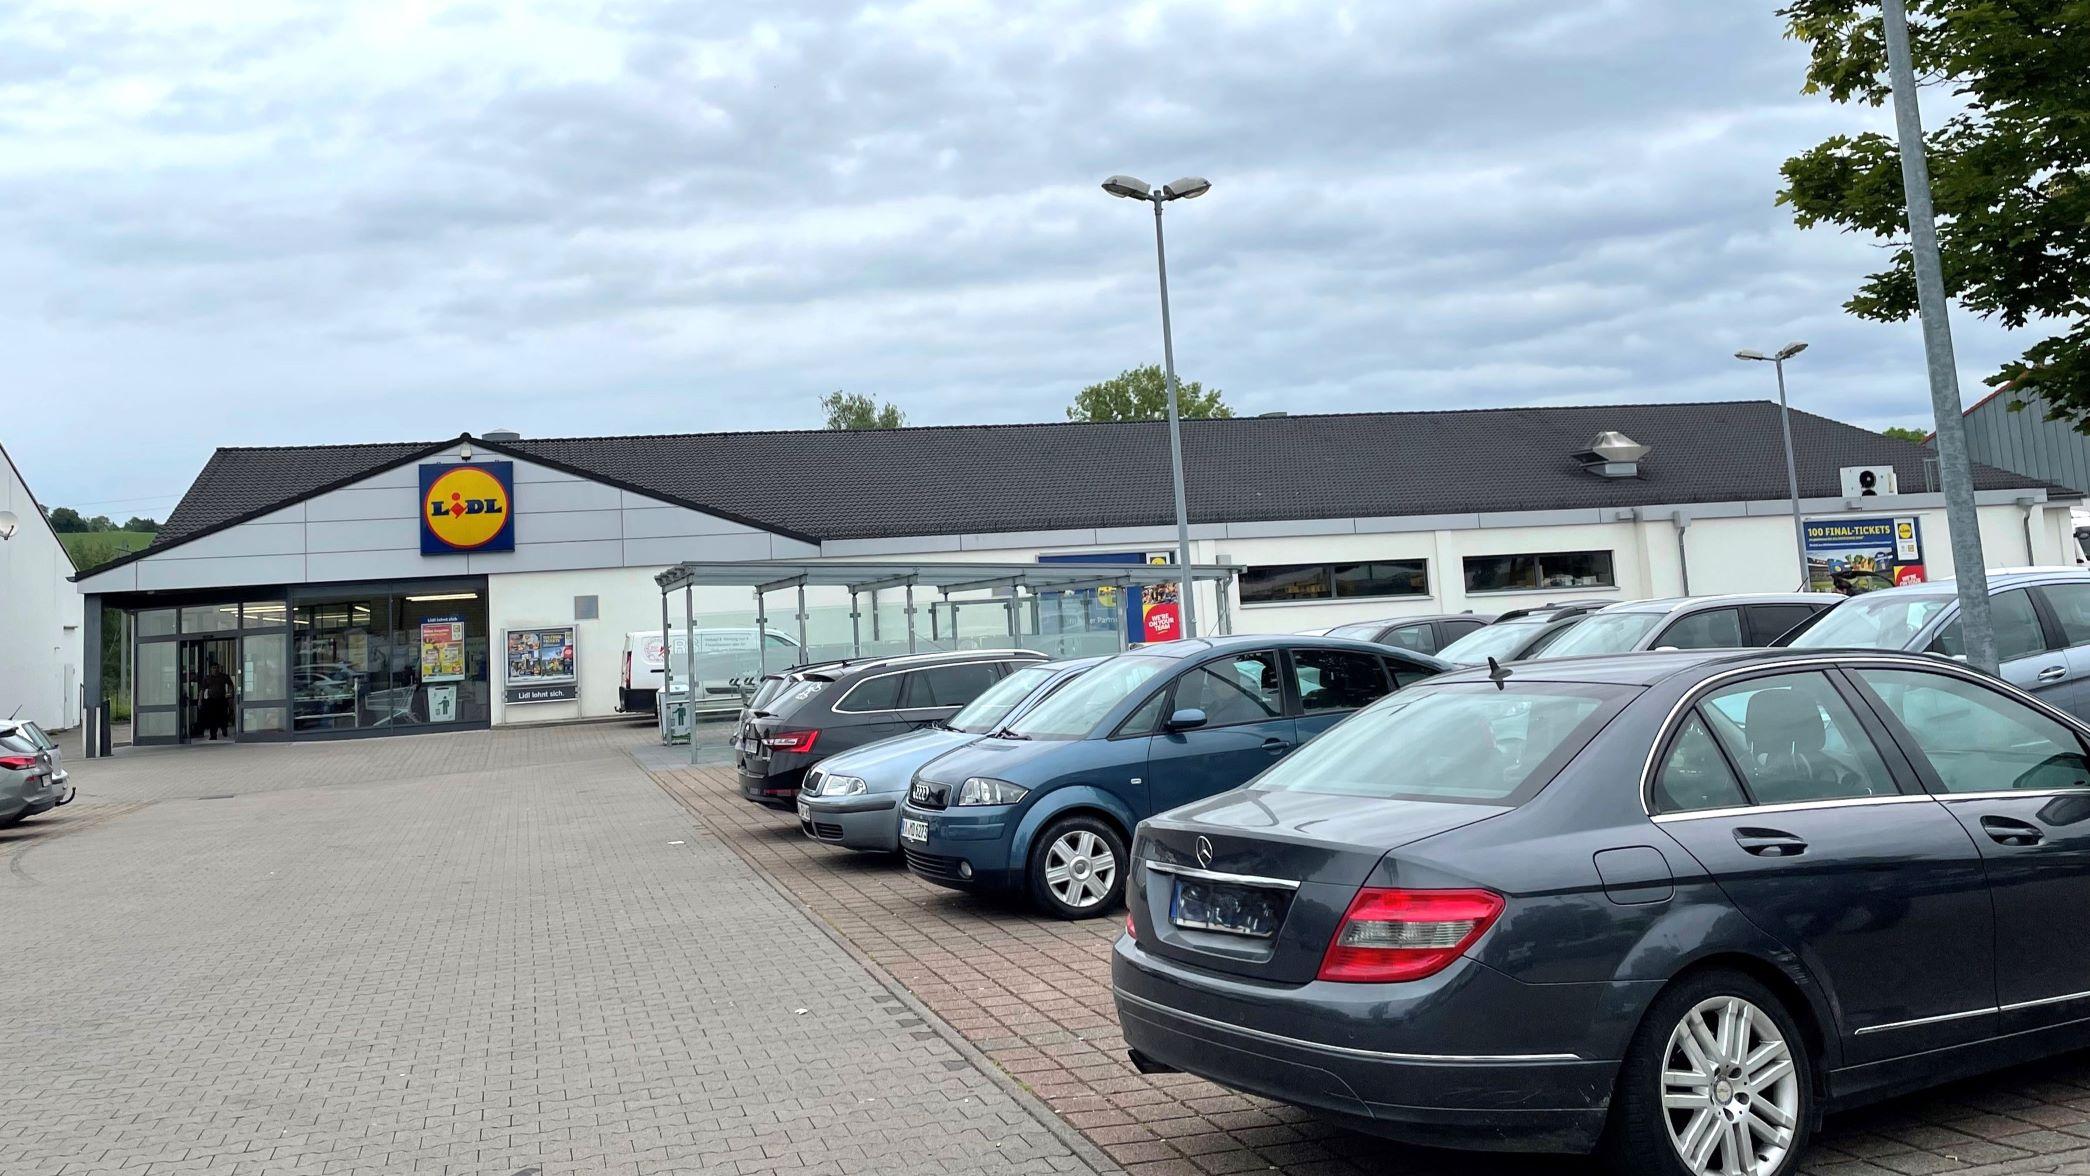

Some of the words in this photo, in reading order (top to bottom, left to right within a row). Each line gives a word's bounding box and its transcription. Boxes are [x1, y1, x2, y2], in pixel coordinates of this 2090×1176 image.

[1807, 527, 1824, 537] 100
[1825, 525, 1891, 536] FINAL-TICKETS
[1148, 620, 1158, 628] ON
[1158, 617, 1174, 627] YOUR
[1151, 613, 1169, 622] WE'RE
[1155, 622, 1171, 632] TEAM
